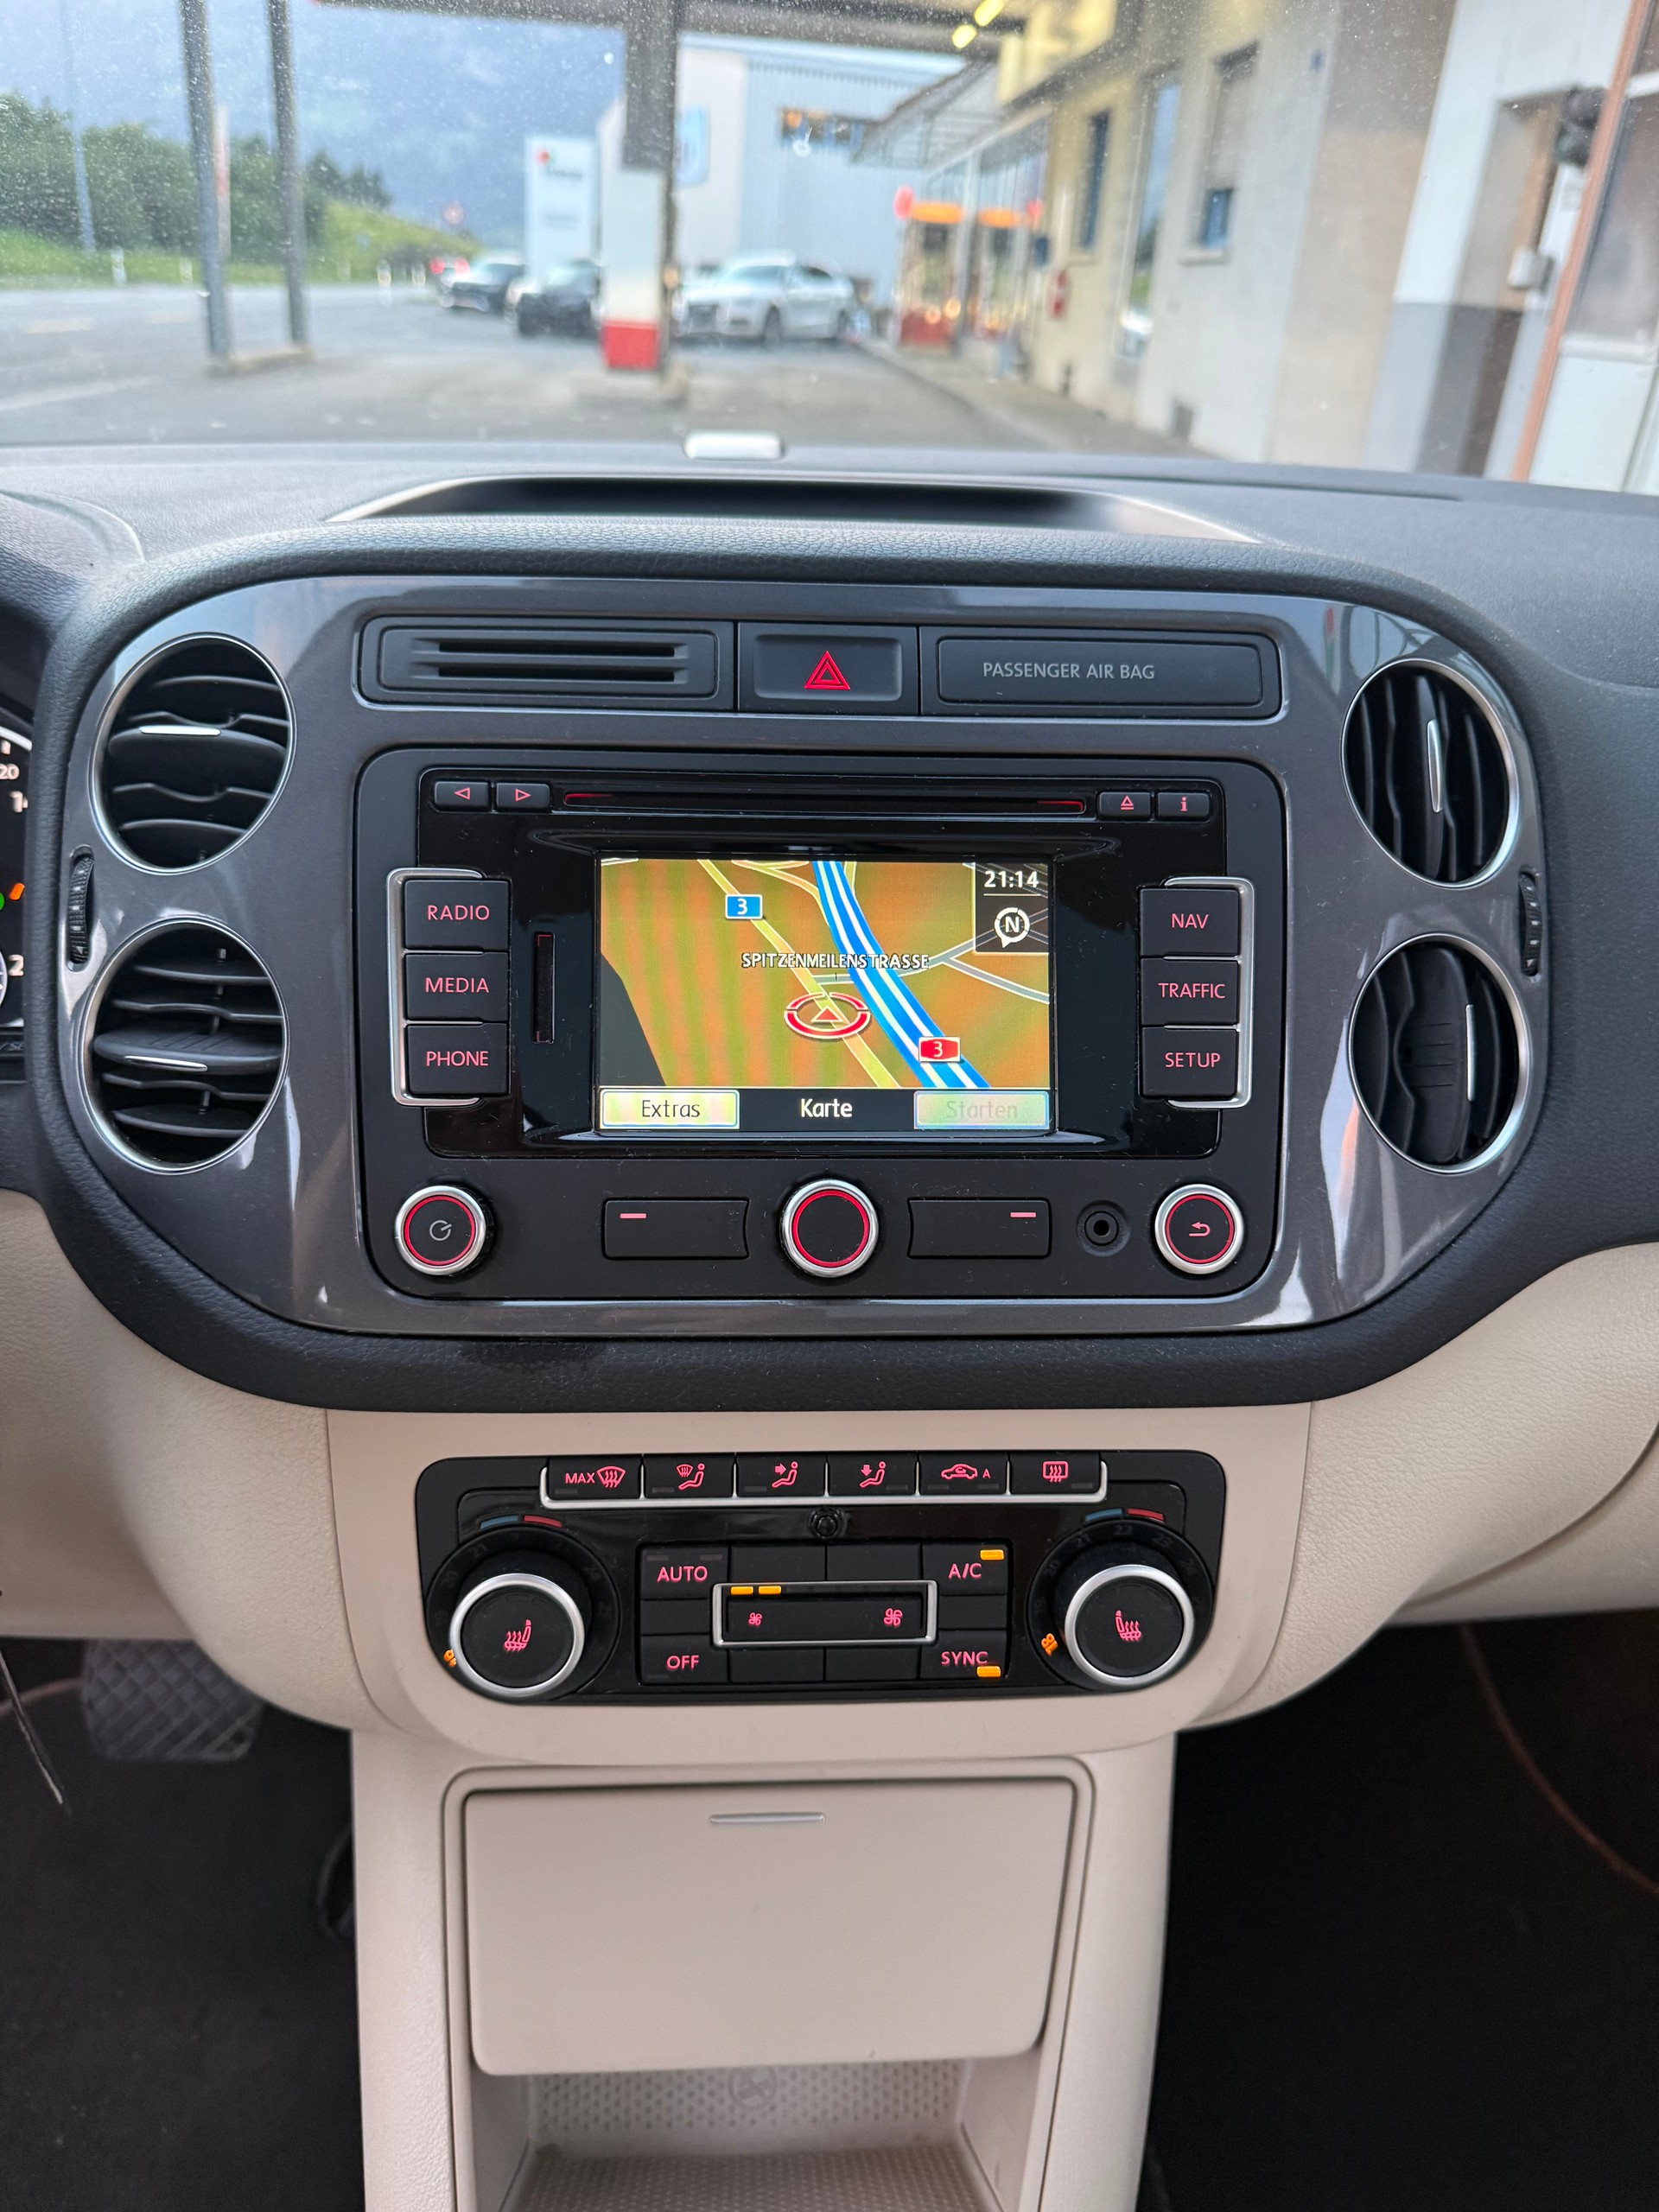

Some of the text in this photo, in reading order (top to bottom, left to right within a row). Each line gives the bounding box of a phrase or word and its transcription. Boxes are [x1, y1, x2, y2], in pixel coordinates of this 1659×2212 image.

[982, 662, 1155, 680] PASSENGER AIR BAG
[983, 870, 1039, 888] 21:14
[427, 904, 490, 922] RADIO
[736, 898, 748, 916] 3
[1005, 916, 1020, 933] N
[1170, 912, 1209, 931] NAV
[741, 952, 930, 969] SPITZENMEILENSTRASSE
[424, 976, 489, 995] MEDIA
[1158, 982, 1225, 1000] TRAFFIC
[932, 1040, 944, 1058] 3
[425, 1050, 488, 1068] PHONE
[1164, 1052, 1221, 1069] SETUP
[641, 1099, 701, 1118] Extras
[800, 1098, 854, 1119] Karte
[946, 1101, 1018, 1119] Starten
[564, 1472, 594, 1484] MAX
[982, 1468, 991, 1479] A
[656, 1565, 709, 1583] AUTO
[948, 1562, 982, 1580] A/C
[665, 1655, 700, 1670] OFF
[940, 1651, 988, 1666] SYNC
